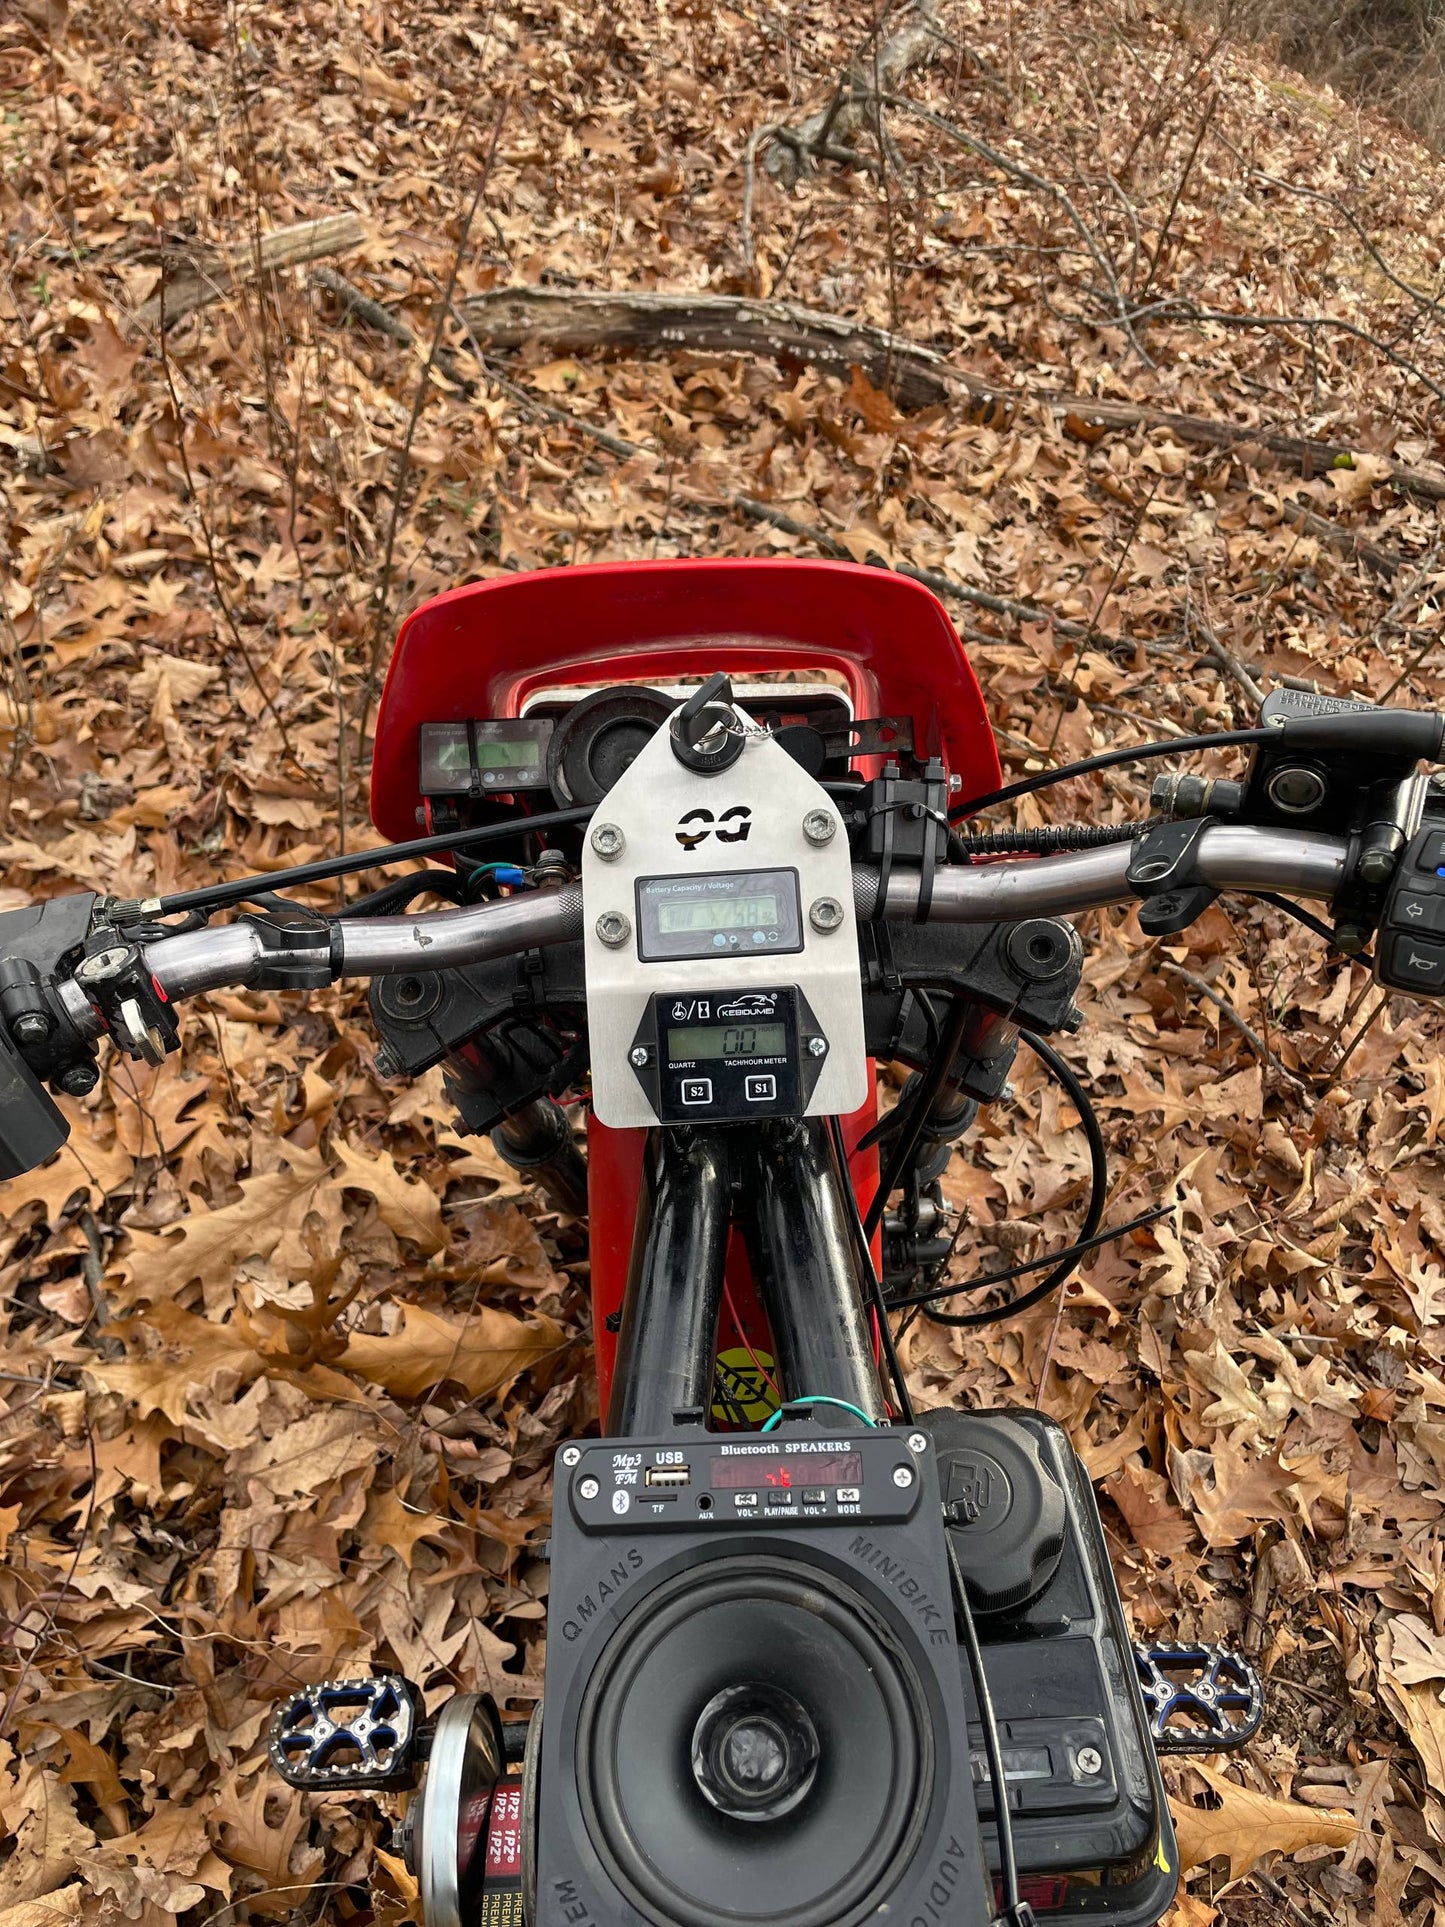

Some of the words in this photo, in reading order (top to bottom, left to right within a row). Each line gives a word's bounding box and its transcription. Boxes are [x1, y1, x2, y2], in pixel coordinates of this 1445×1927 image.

[646, 885, 671, 896] Battery
[672, 883, 702, 894] Capacity
[707, 880, 734, 890] Voltage
[668, 1061, 696, 1069] QUARTZ
[724, 1058, 763, 1067] TACH/HOUR
[763, 1057, 788, 1065] METER
[690, 1086, 704, 1097] S2
[754, 1083, 768, 1094] S1
[720, 1445, 780, 1456] Bluetooth
[784, 1441, 852, 1454] SPEAKERS
[612, 1453, 642, 1470] Mp3
[655, 1451, 684, 1465] USB
[614, 1472, 638, 1486] FM
[652, 1504, 665, 1513] TF
[764, 1506, 799, 1516] PLAY/PAUSE
[837, 1504, 862, 1514] MODE
[698, 1511, 714, 1520] AUX
[561, 1548, 644, 1643] QMANS
[848, 1535, 950, 1648] MINIBIKE
